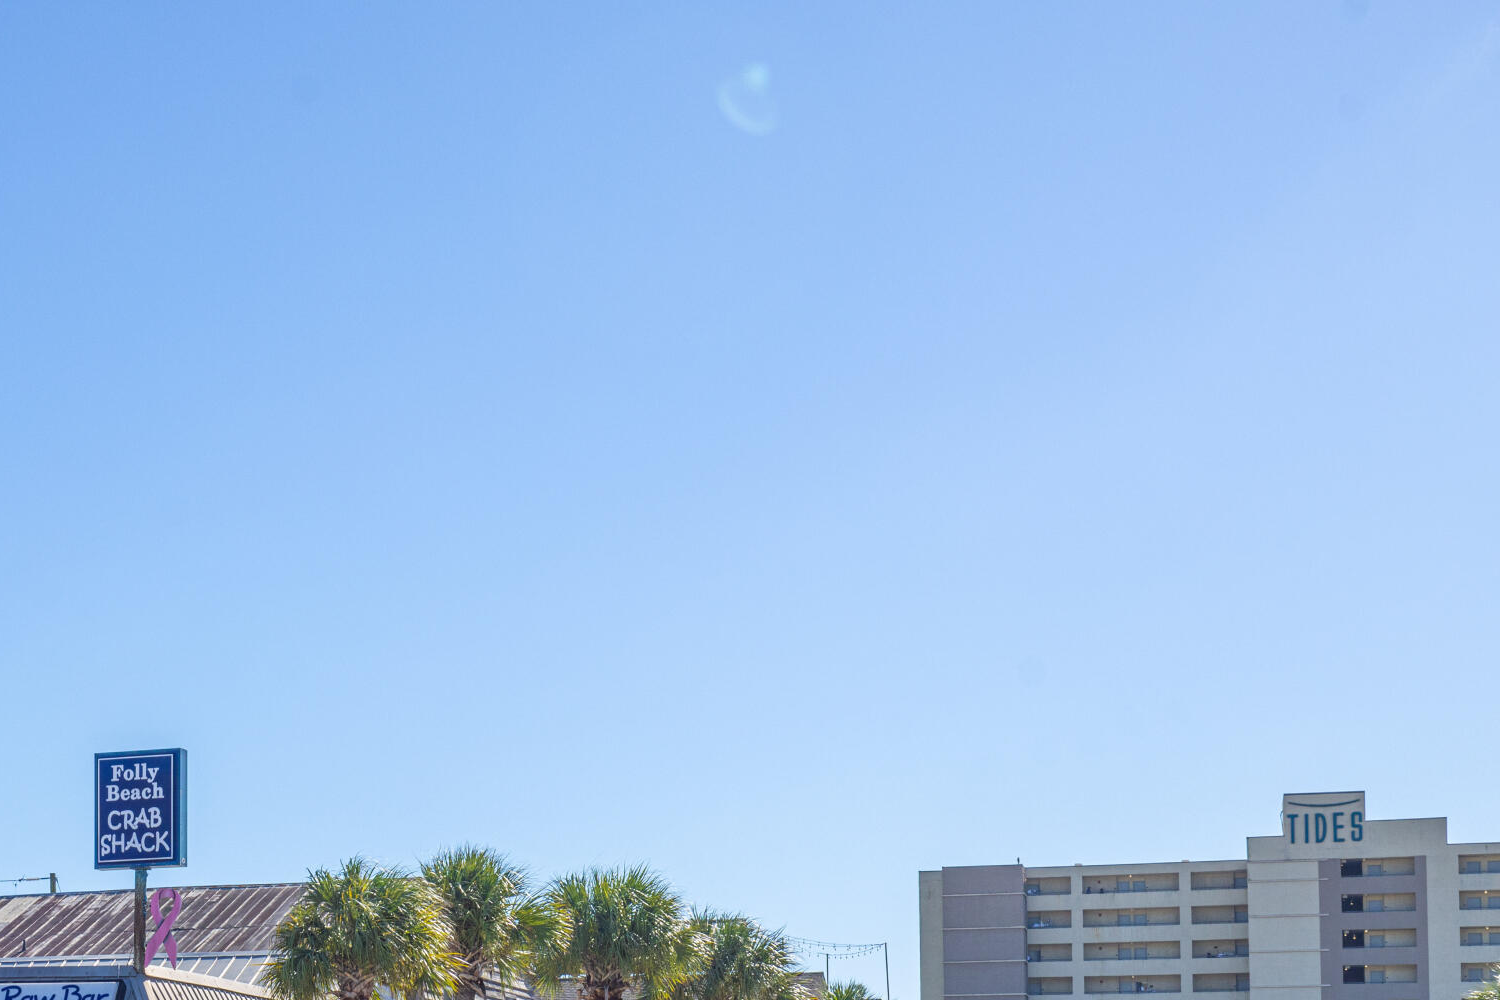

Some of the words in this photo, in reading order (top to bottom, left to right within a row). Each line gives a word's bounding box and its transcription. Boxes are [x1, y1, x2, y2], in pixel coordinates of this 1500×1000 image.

[111, 763, 159, 783] Folly
[106, 782, 164, 802] Beach
[107, 807, 162, 830] CRAB
[1286, 811, 1363, 844] TIDES
[100, 831, 170, 857] SHACK
